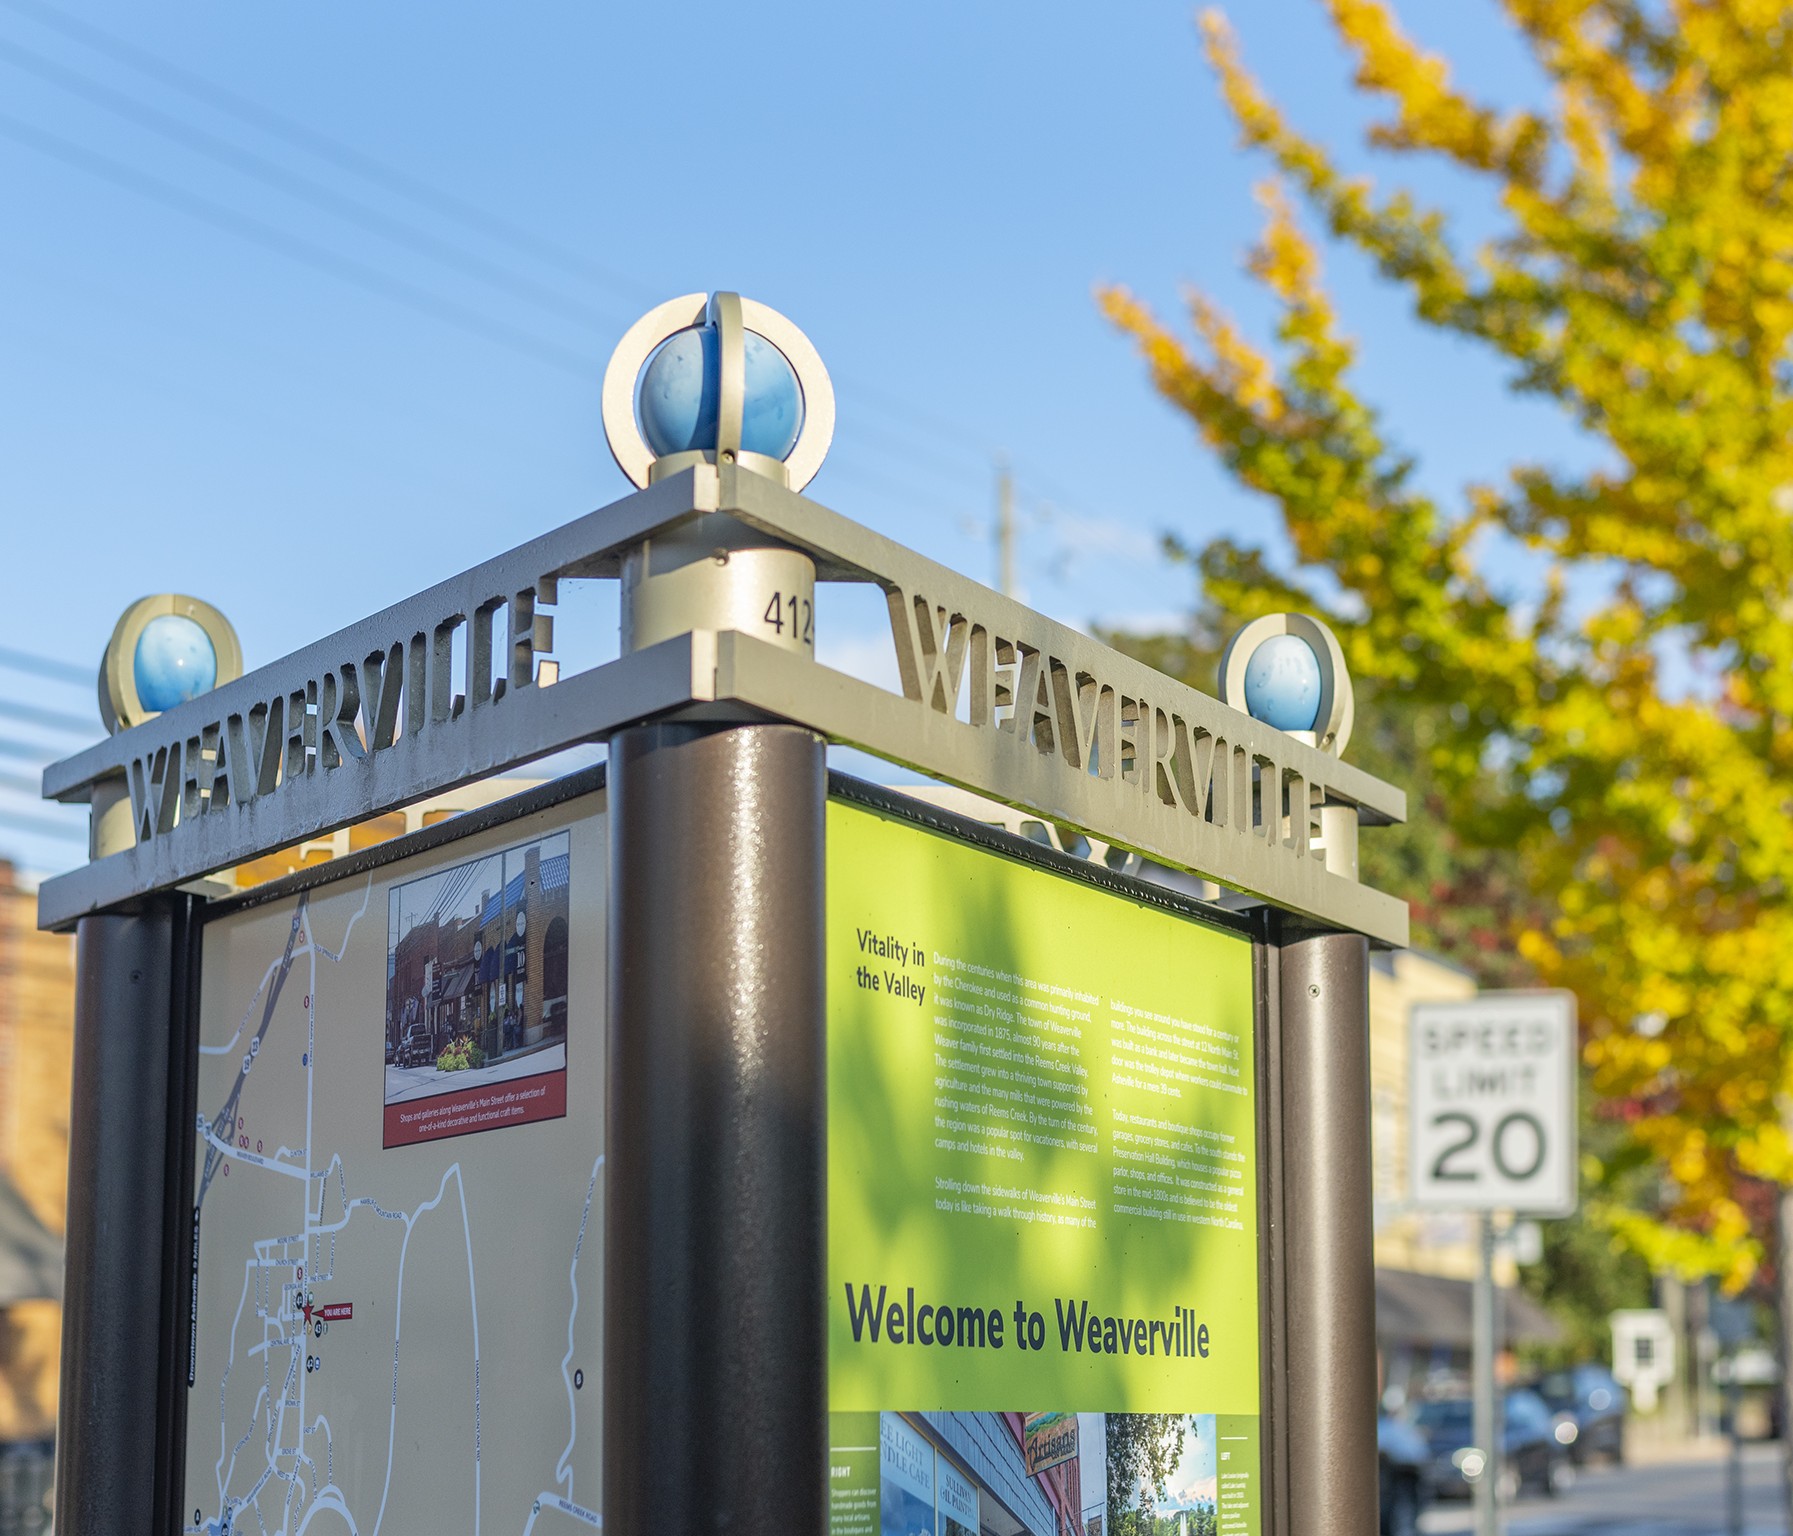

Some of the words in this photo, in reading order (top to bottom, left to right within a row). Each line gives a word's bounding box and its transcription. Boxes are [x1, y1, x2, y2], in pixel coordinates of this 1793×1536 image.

[126, 577, 559, 847] WEAVERVILLE
[890, 587, 1327, 863] WEAVERVILLE
[856, 928, 908, 967] Vitality
[912, 942, 925, 966] in
[856, 966, 879, 991] the
[884, 970, 925, 1006] Valley
[934, 953, 954, 971] During
[956, 959, 966, 971] the
[967, 964, 994, 978] centuries
[995, 970, 1011, 983] when
[1013, 974, 1023, 986] this
[1024, 979, 1036, 989] area
[1038, 983, 1048, 992] was
[934, 973, 941, 989] by
[943, 976, 953, 989] the
[954, 978, 982, 995] Cherokee
[984, 987, 995, 998] and
[996, 991, 1010, 1002] used
[1012, 995, 1018, 1004] as
[1019, 997, 1022, 1005] a
[1024, 998, 1048, 1011] common
[1049, 1001, 1070, 1018] hunting
[1071, 1009, 1091, 1022] ground,
[934, 994, 938, 1006] it
[940, 998, 952, 1009] was
[953, 998, 974, 1014] known
[976, 1006, 982, 1016] as
[984, 1006, 994, 1021] Dry
[996, 1009, 1014, 1024] Ridge.
[1016, 1013, 1026, 1025] The
[1027, 1017, 1042, 1029] town
[1043, 1020, 1049, 1031] of
[1050, 1022, 1082, 1038] Weaverville
[934, 1017, 947, 1028] was
[948, 1017, 986, 1036] incorporated
[988, 1026, 993, 1037] in
[1012, 1032, 1031, 1046] almost
[1032, 1036, 1040, 1047] 90
[1041, 1041, 1055, 1051] years
[1057, 1042, 1069, 1054] after
[1070, 1045, 1080, 1056] the
[934, 1034, 958, 1050] Weaver
[959, 1039, 977, 1056] family
[979, 1043, 990, 1056] first
[992, 1048, 1011, 1060] settled
[1013, 1050, 1023, 1063] into
[1025, 1054, 1033, 1065] the
[1035, 1055, 1053, 1069] Reems
[1055, 1059, 1070, 1072] Creek
[1071, 1063, 1088, 1078] Valley.
[1424, 1021, 1553, 1057] SPEED
[1431, 1066, 1537, 1097] LIMIT
[400, 1114, 413, 1123] Shops
[422, 1109, 438, 1120] galleries
[440, 1106, 451, 1115] along
[452, 1100, 479, 1113] Weaverville's
[480, 1099, 490, 1107] Main
[491, 1095, 504, 1105] Street
[505, 1092, 515, 1102] offer
[520, 1089, 540, 1100] selection
[541, 1086, 546, 1096] of
[419, 1120, 446, 1132] one-of-a-kind
[447, 1117, 468, 1127] decorative
[469, 1113, 477, 1123] and
[478, 1109, 500, 1121] functional
[500, 1106, 510, 1117] craft
[935, 1140, 955, 1152] camps
[957, 1141, 968, 1152] and
[970, 1142, 987, 1154] hotels
[989, 1144, 994, 1155] in
[996, 1146, 1005, 1157] the
[1007, 1148, 1024, 1162] valley.
[1430, 1110, 1547, 1182] 20
[936, 1178, 961, 1194] Strolling
[962, 1182, 979, 1194] down
[981, 1184, 990, 1195] the
[992, 1186, 1020, 1199] sidewalks
[1021, 1190, 1027, 1200] of
[1029, 1190, 1064, 1205] Weaverville's
[1065, 1195, 1078, 1207] Main
[1080, 1197, 1096, 1209] Street
[845, 1282, 1004, 1349] Welcome
[1014, 1300, 1045, 1351] to
[1054, 1298, 1209, 1358] Weaverville
[896, 1431, 923, 1466] LIGHT
[1027, 1429, 1075, 1471] Artisans
[831, 1466, 851, 1478] RIGHT
[909, 1463, 930, 1489] CAFE
